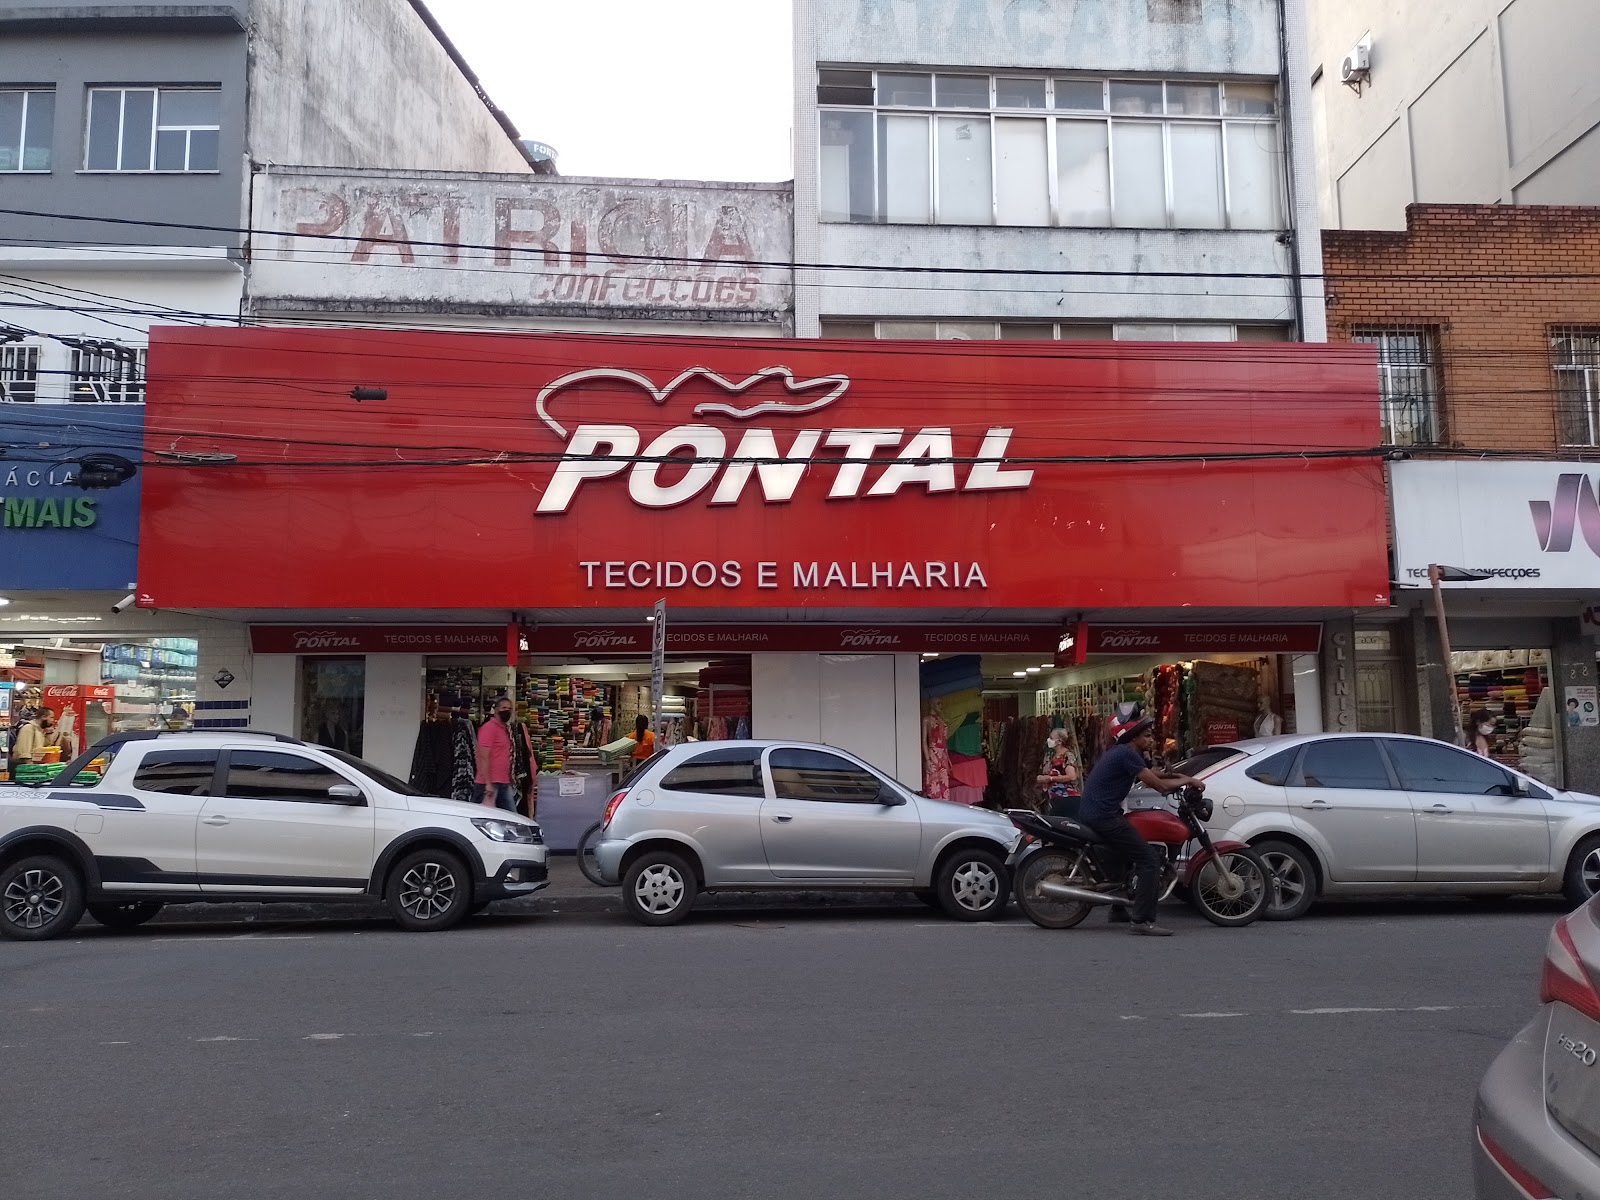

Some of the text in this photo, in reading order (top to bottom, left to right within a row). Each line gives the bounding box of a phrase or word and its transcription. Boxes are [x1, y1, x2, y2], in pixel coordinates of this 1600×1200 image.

[534, 424, 1034, 514] PONTAL
[580, 561, 987, 588] TECIDOS E MALHARIA
[295, 635, 498, 648] PONTAL TECIDOS E MALHARIA
[574, 633, 768, 648] PONTAL ECIDOS E MALHARIA
[840, 633, 1030, 647] PONTAL TECIDOS E MALHARIA
[1100, 633, 1288, 647] PONTAL TECIDOS E MALHARIA
[1332, 632, 1349, 732] CLÍNIC
[1559, 1033, 1597, 1067] HB20
